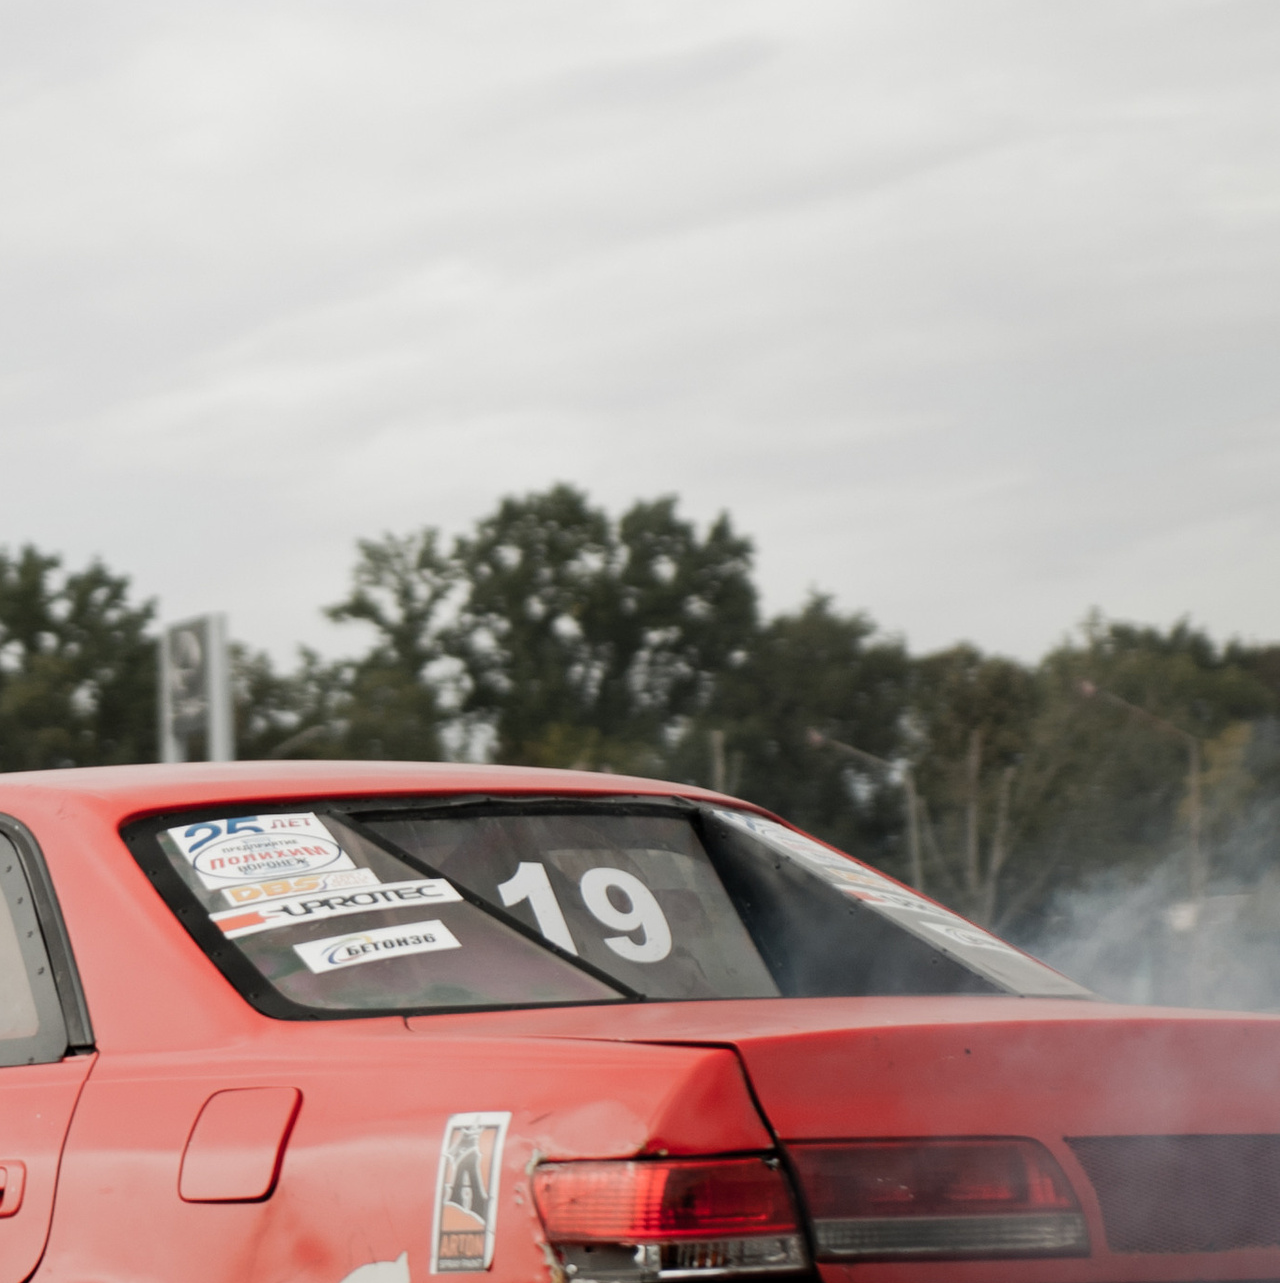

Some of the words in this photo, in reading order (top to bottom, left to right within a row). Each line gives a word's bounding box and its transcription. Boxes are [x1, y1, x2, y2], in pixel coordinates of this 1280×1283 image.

[184, 816, 264, 853] 25
[209, 845, 330, 871] ПОЛИХИМ
[229, 875, 322, 903] DBS
[497, 861, 673, 964] 19
